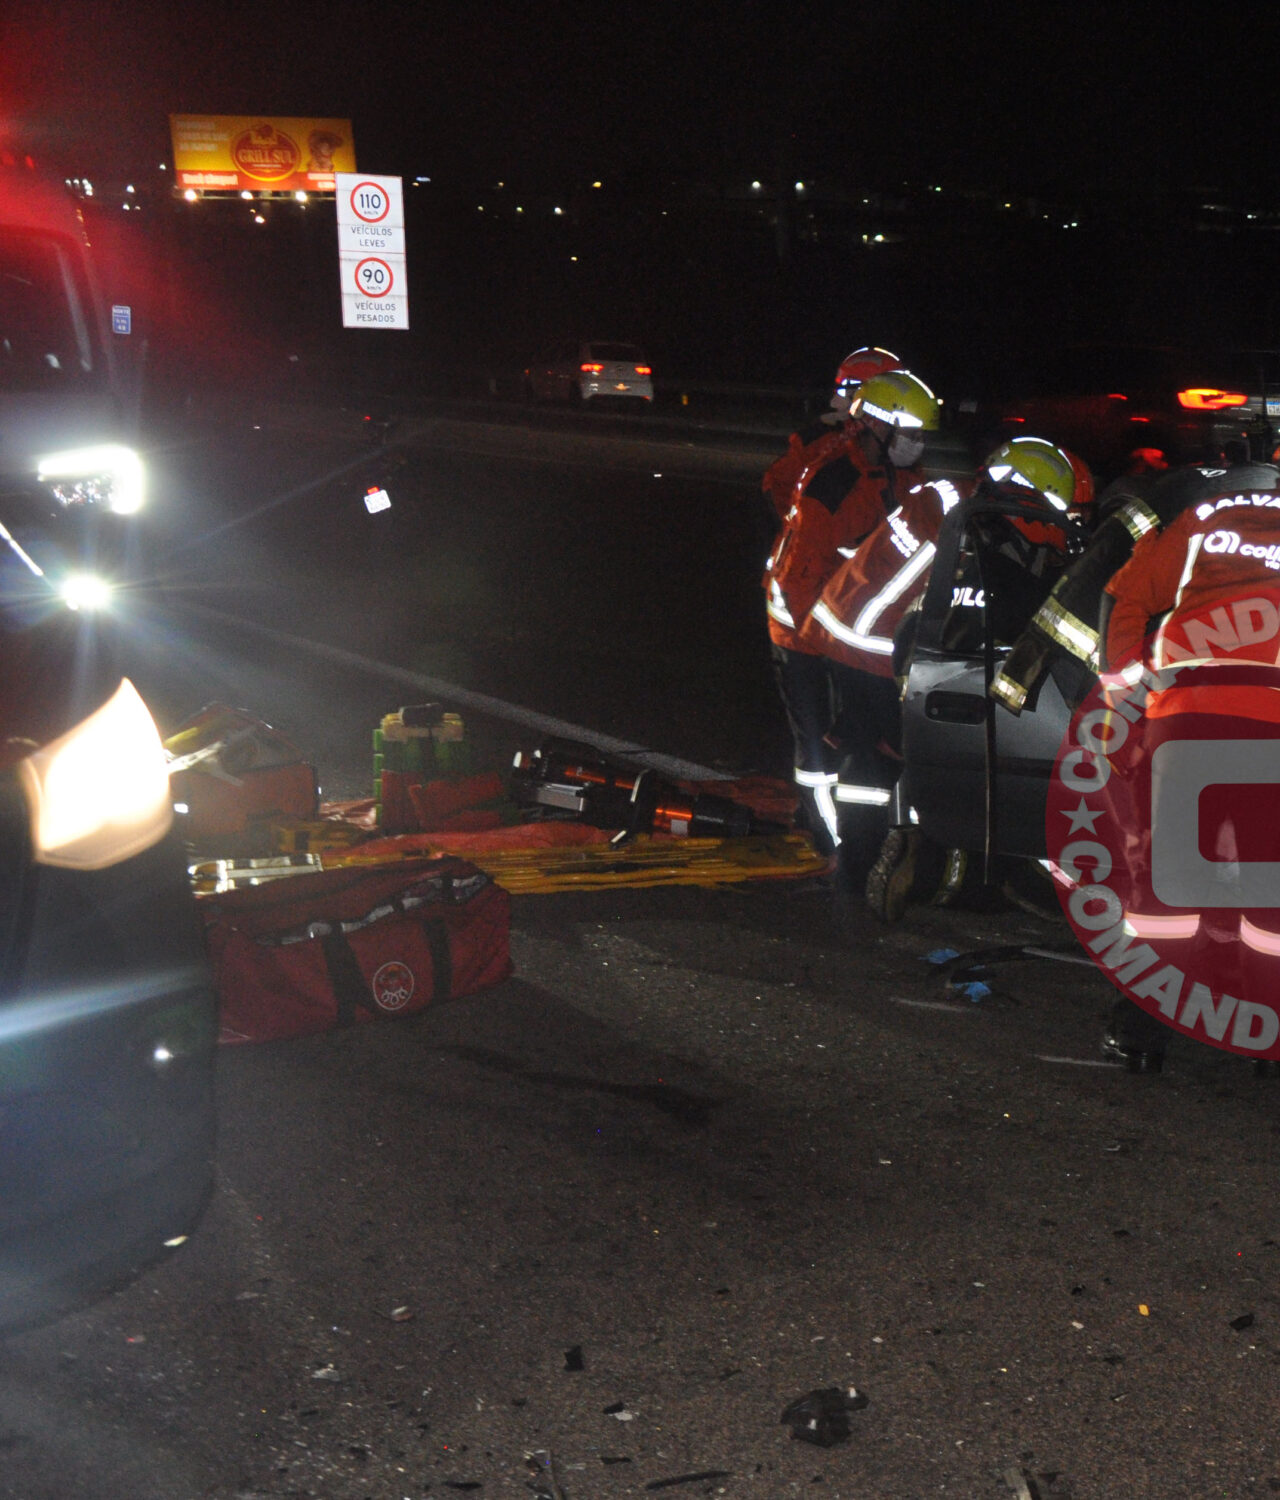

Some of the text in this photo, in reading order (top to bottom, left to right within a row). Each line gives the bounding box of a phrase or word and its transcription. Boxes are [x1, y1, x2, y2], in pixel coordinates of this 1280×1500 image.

[360, 193, 381, 209] 110
[351, 225, 393, 236] VEÍCULOS
[359, 239, 386, 248] LEVES
[362, 268, 384, 284] 90
[355, 300, 396, 311] VEÍCULOS
[356, 313, 395, 323] PESADOS
